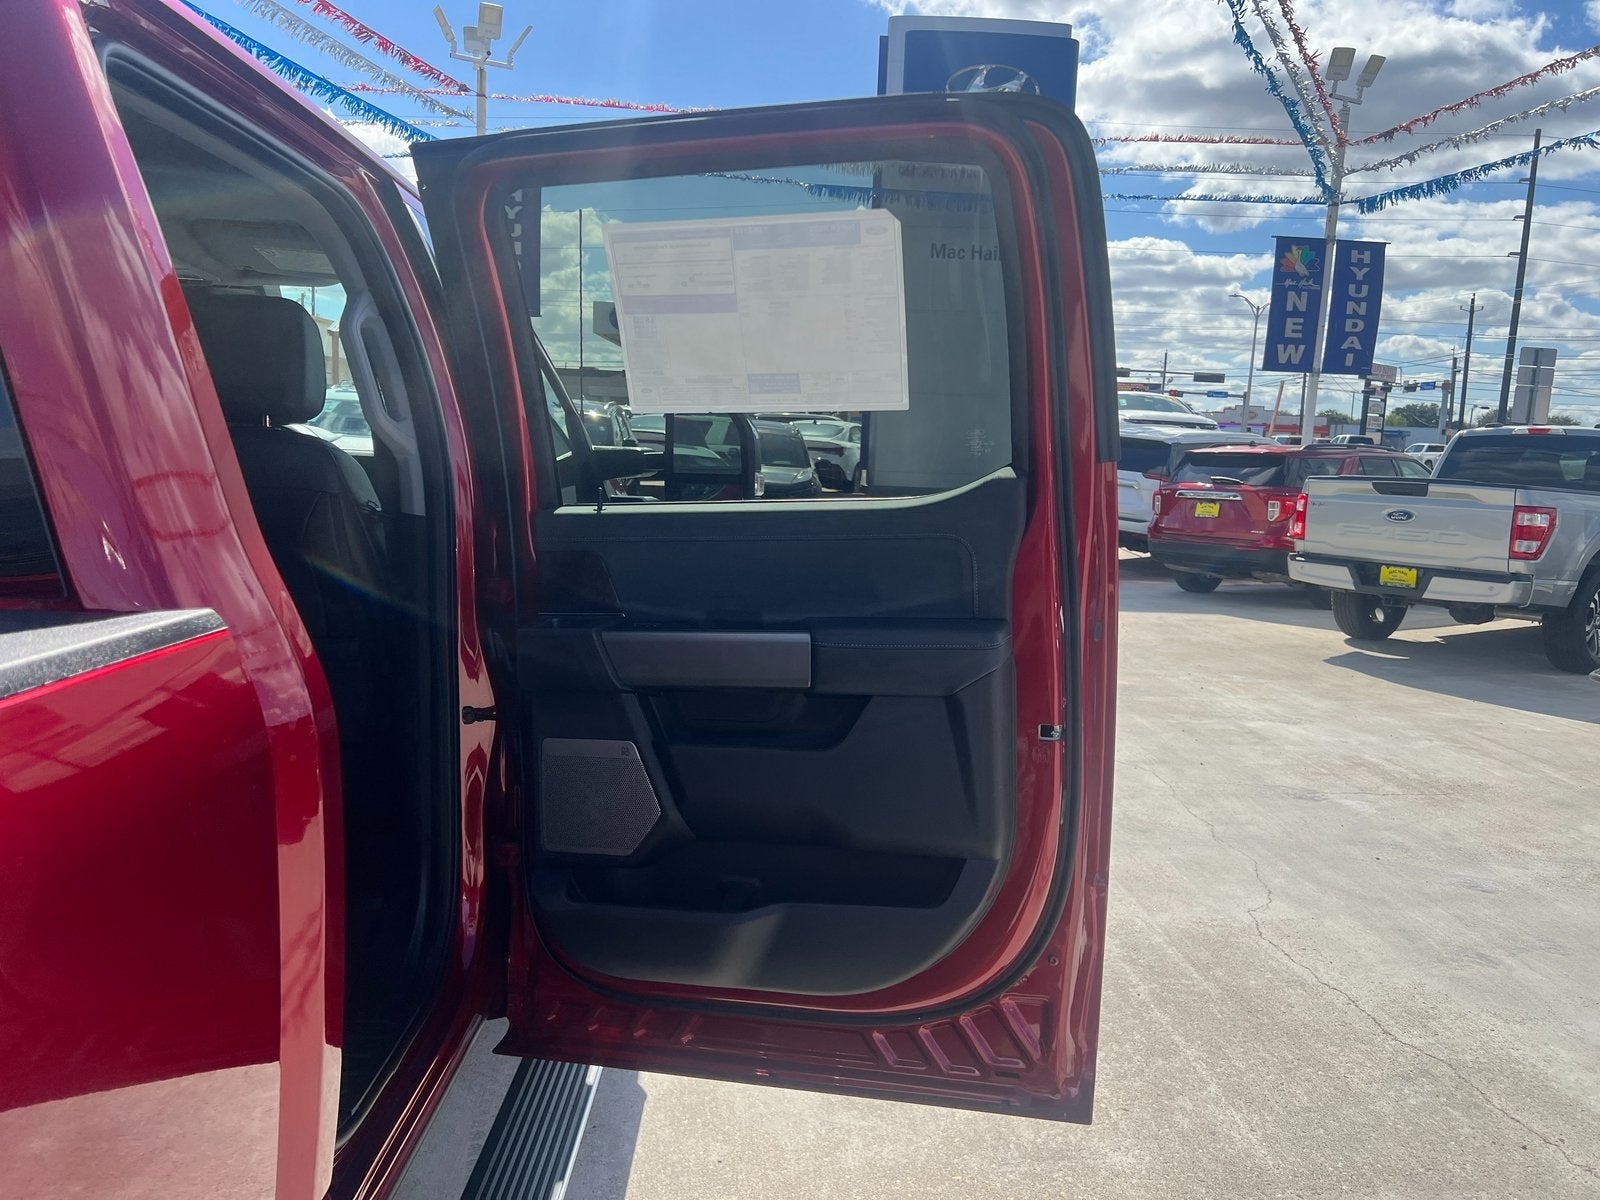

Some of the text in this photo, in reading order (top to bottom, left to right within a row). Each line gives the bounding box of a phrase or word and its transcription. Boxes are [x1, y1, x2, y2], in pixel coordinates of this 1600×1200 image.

[930, 243, 1001, 261] Mac Hai
[1341, 249, 1371, 367] HYUNDAI
[1277, 291, 1308, 365] NEW
[1390, 512, 1409, 521] Ford
[1336, 523, 1469, 545] F-150
